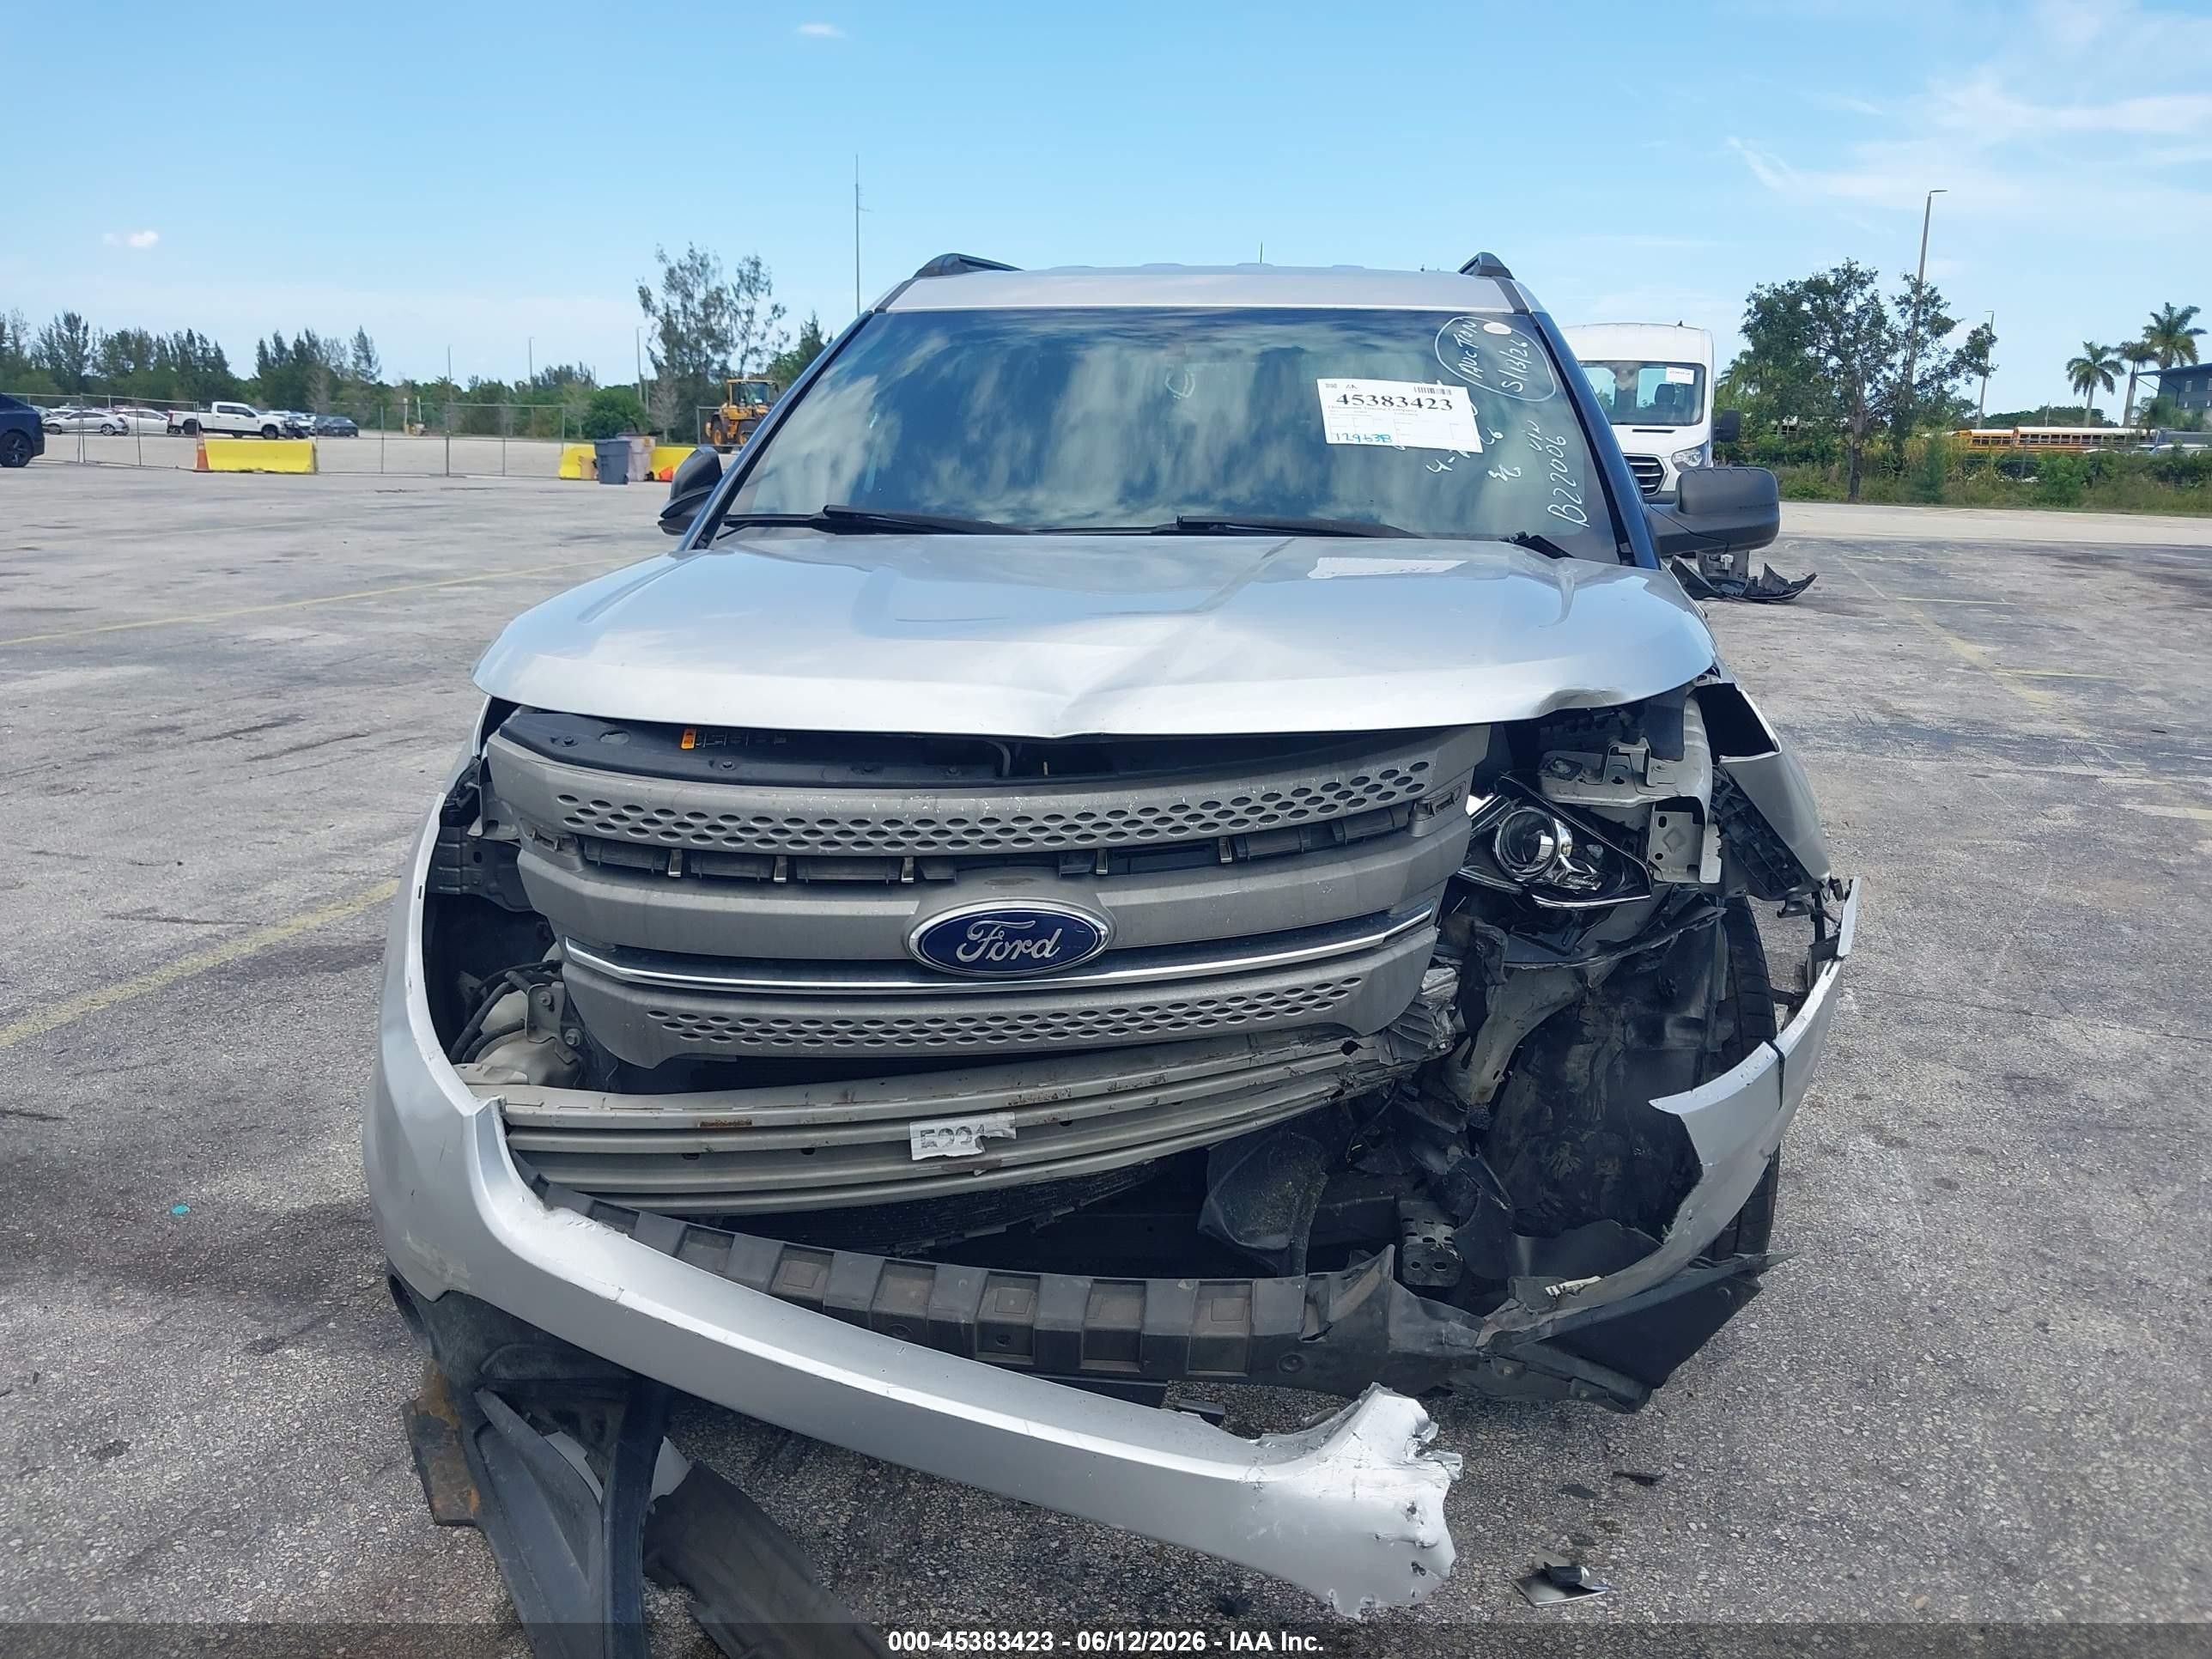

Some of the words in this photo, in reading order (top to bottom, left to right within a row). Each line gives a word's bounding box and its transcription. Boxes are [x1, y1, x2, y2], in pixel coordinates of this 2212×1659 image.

[1335, 393, 1453, 411] 45383423
[1546, 435, 1590, 528] B22006
[956, 920, 1063, 963] Ford
